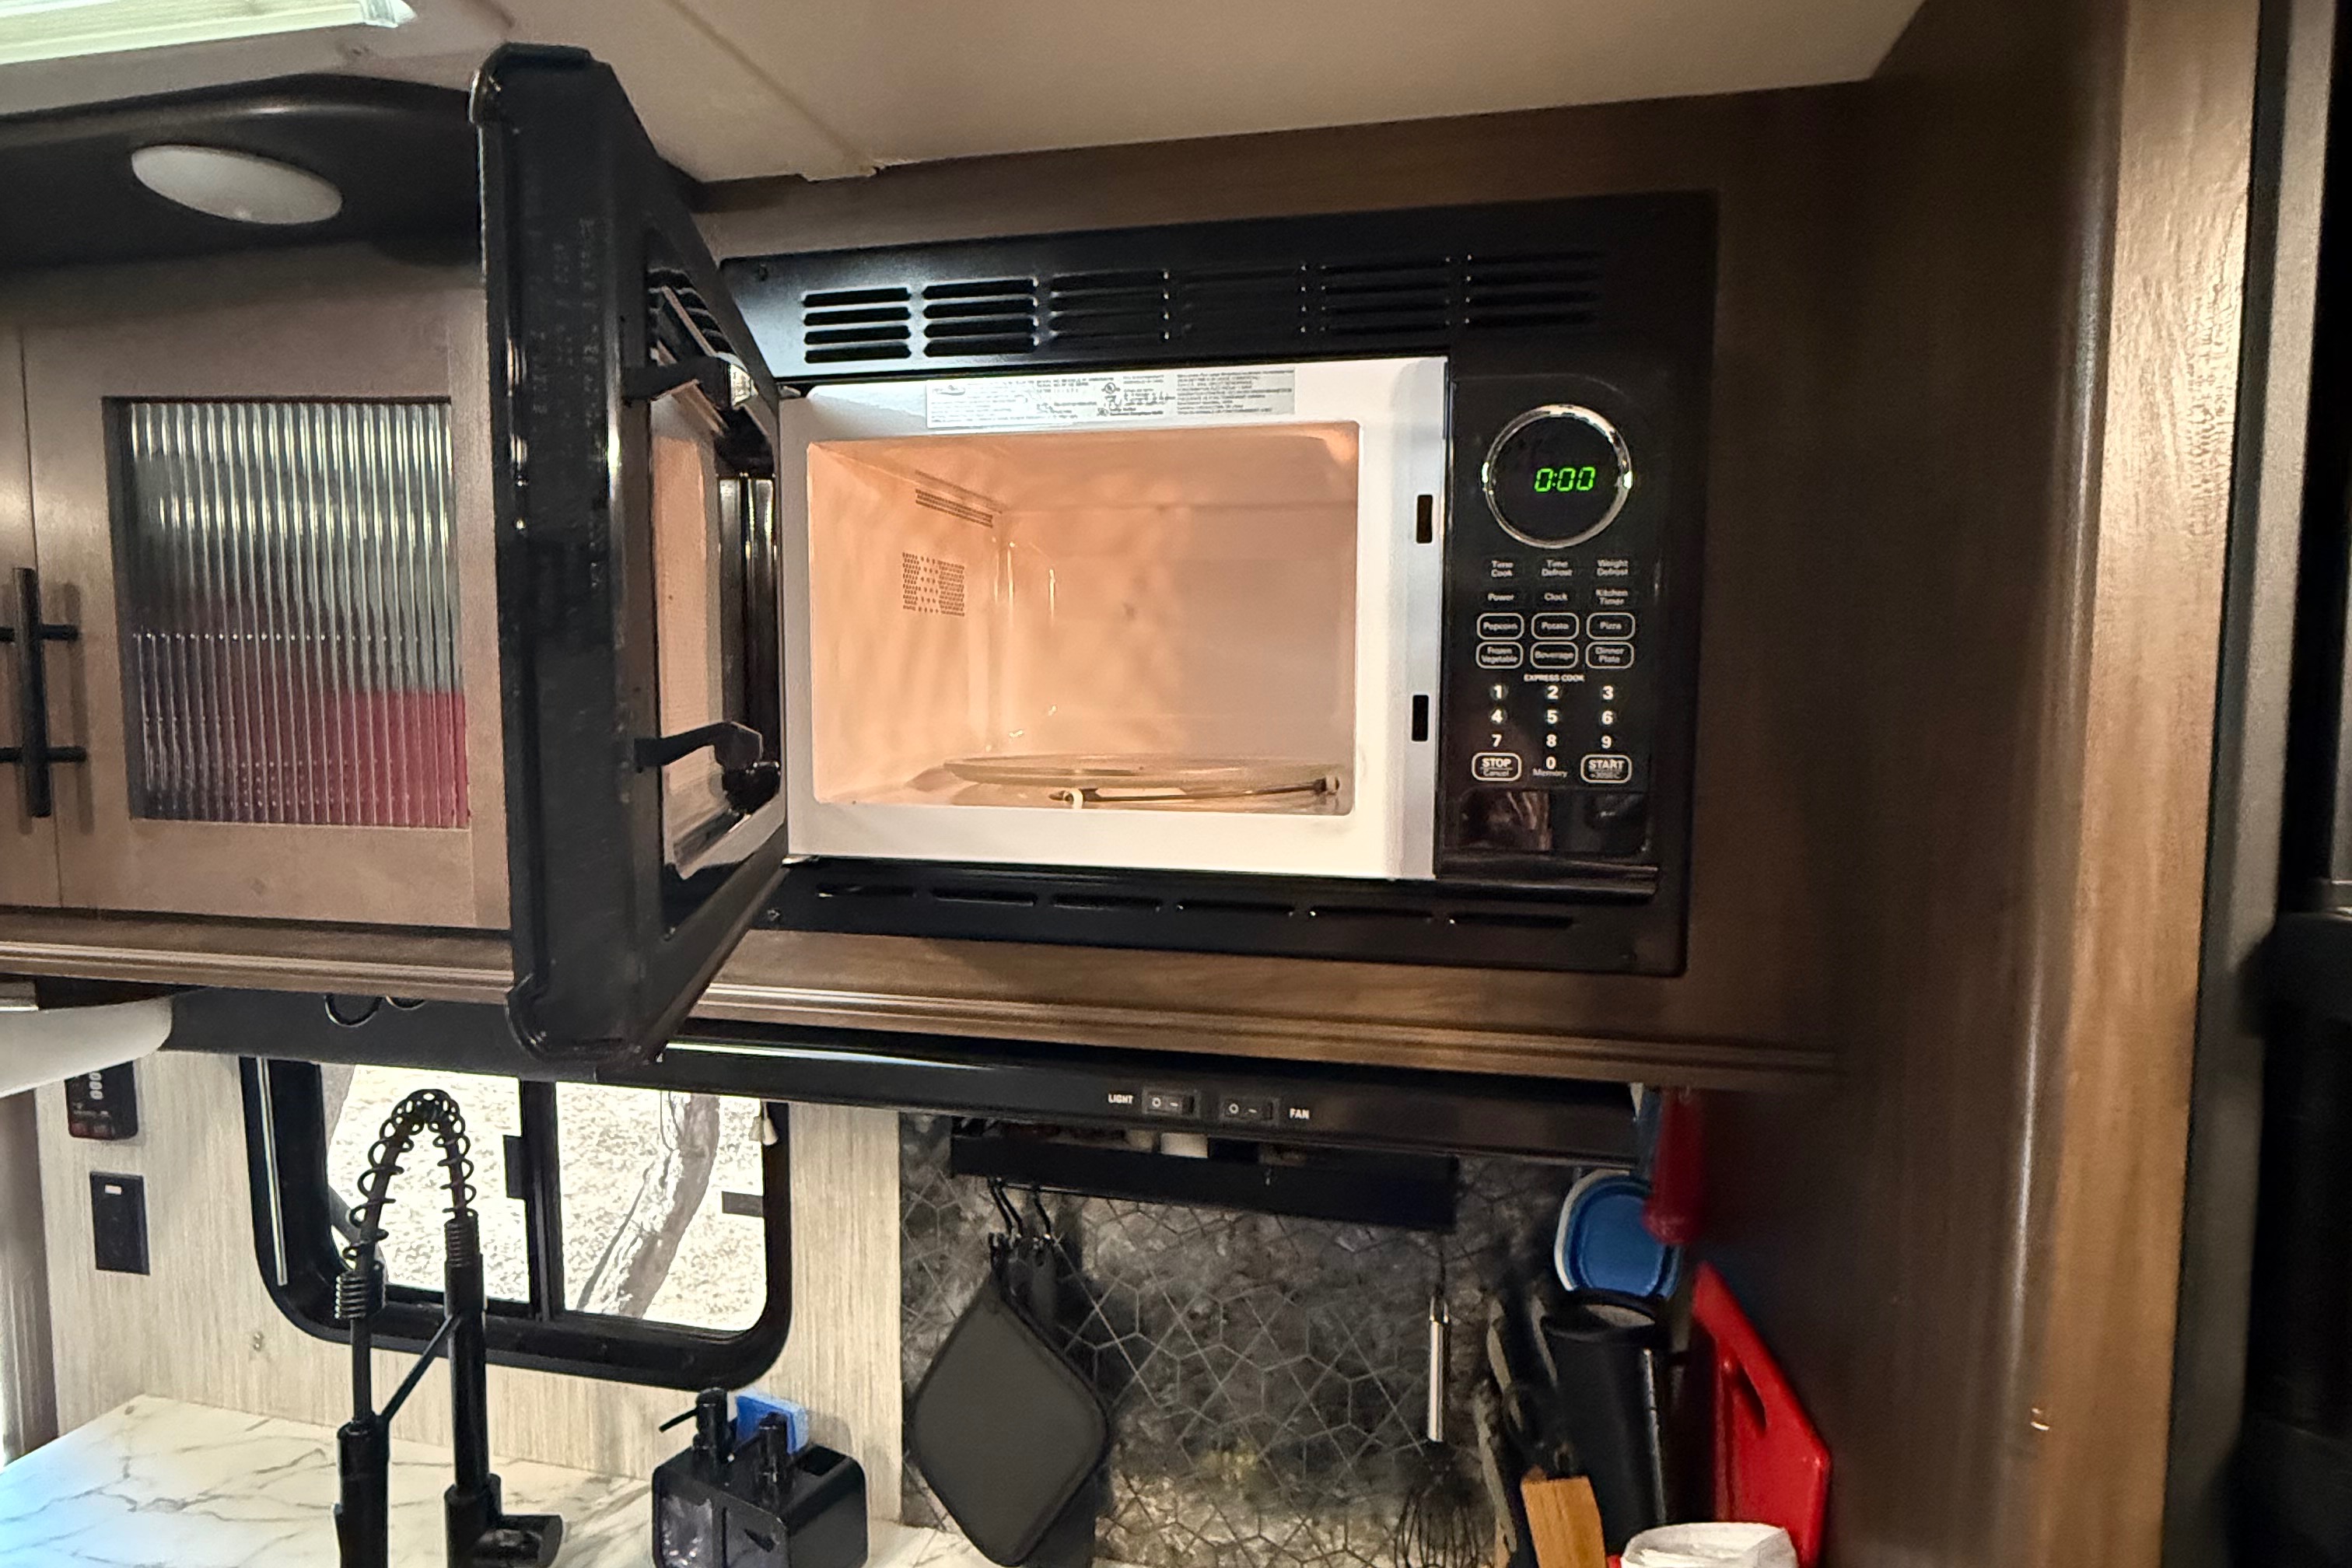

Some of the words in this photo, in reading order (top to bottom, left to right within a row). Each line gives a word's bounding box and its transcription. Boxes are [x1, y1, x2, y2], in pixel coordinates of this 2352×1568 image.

[1534, 467, 1596, 492] 0:00
[1492, 560, 1514, 569] Time
[1546, 559, 1568, 568] Time
[1491, 569, 1513, 578] Cook
[1542, 569, 1573, 577] Defrost
[1544, 593, 1568, 601] Clock
[1483, 621, 1517, 631] Popcorn
[1542, 621, 1570, 630] Potato
[1600, 621, 1622, 630] Pizza
[1535, 650, 1574, 660] Beverage
[1524, 674, 1559, 682] EXPRESS
[1562, 674, 1585, 682] COOK
[1493, 684, 1503, 699] 1
[1547, 685, 1559, 700] 2
[1602, 685, 1615, 700] 3
[1490, 709, 1503, 723] 4
[1547, 709, 1559, 724] 5
[1601, 710, 1614, 725] 6
[1491, 733, 1503, 747] 7
[1546, 734, 1557, 747] 8
[1601, 735, 1612, 749] 9
[1482, 758, 1512, 768] STOP
[1546, 757, 1556, 770] 0
[1588, 759, 1626, 771] START
[1532, 768, 1568, 777] Memory
[1108, 1094, 1134, 1104] LIGHT
[1290, 1108, 1311, 1120] FAN
